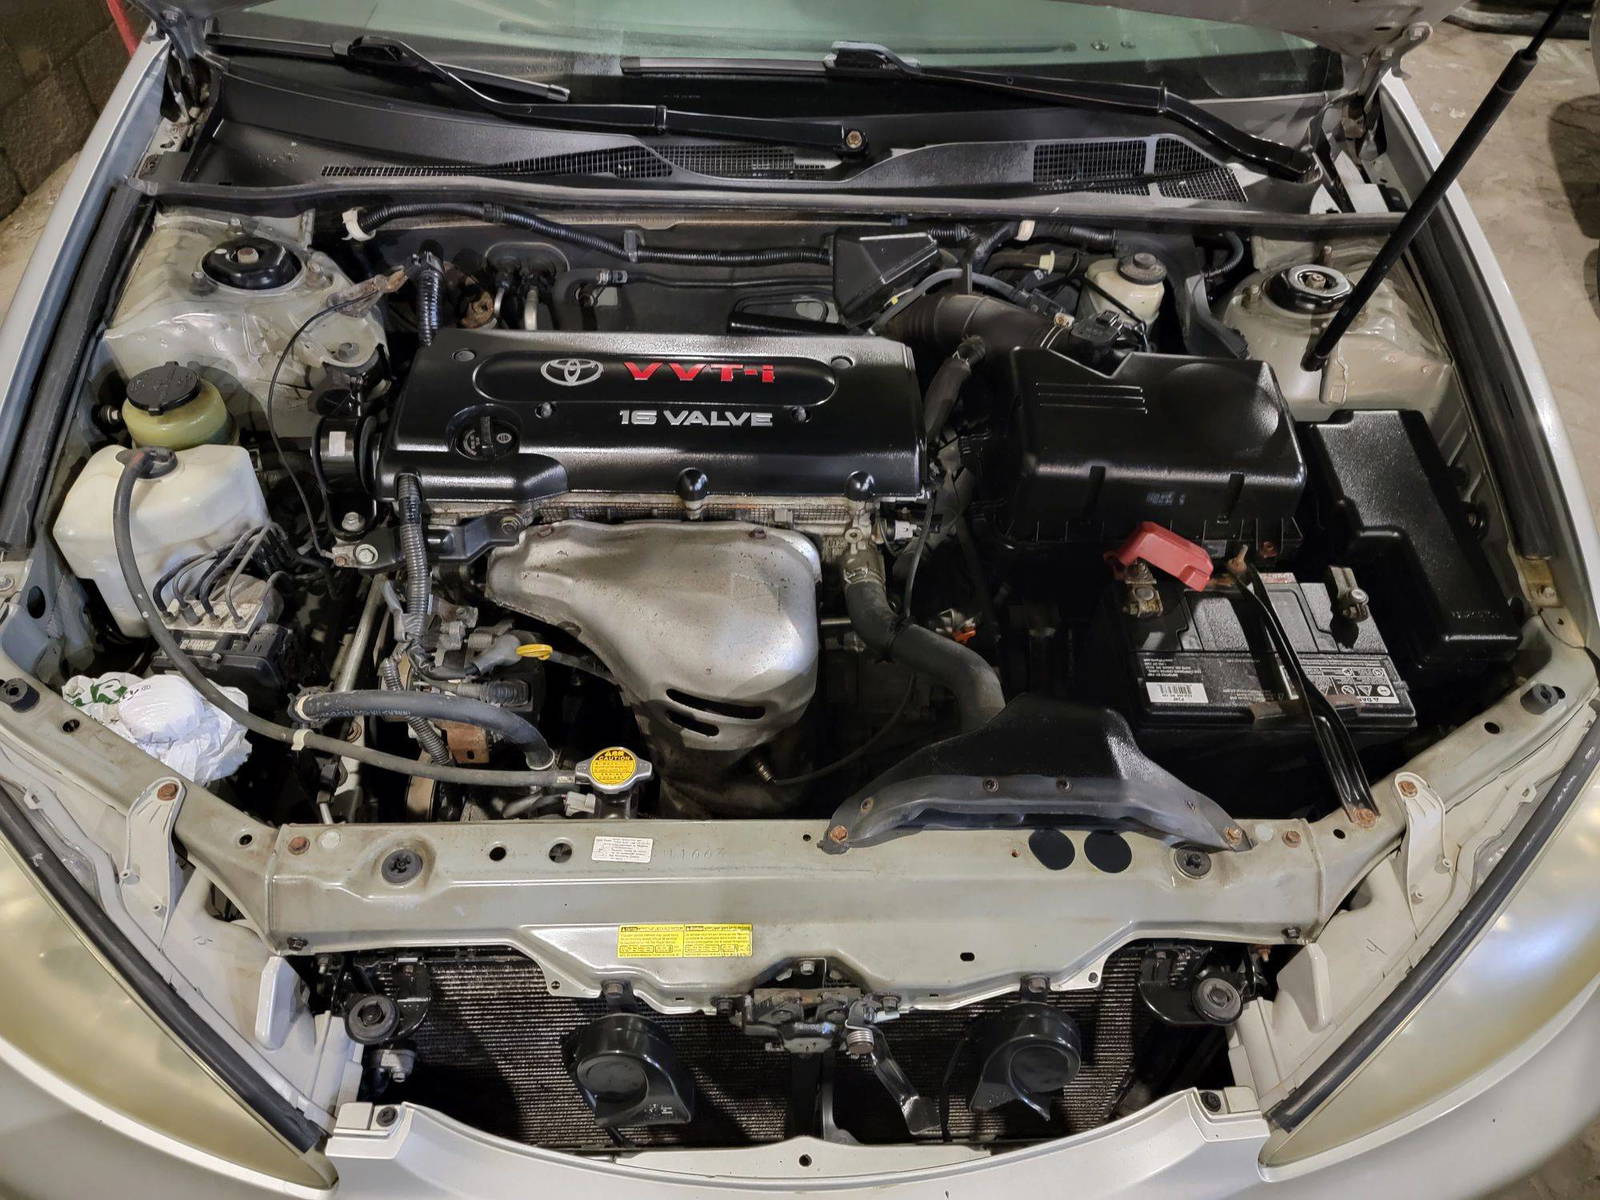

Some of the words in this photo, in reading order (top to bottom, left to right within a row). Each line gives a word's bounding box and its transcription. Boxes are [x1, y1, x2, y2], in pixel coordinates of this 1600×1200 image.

[624, 361, 775, 383] VVT-i
[619, 409, 658, 425] 16
[663, 410, 773, 427] VALVE
